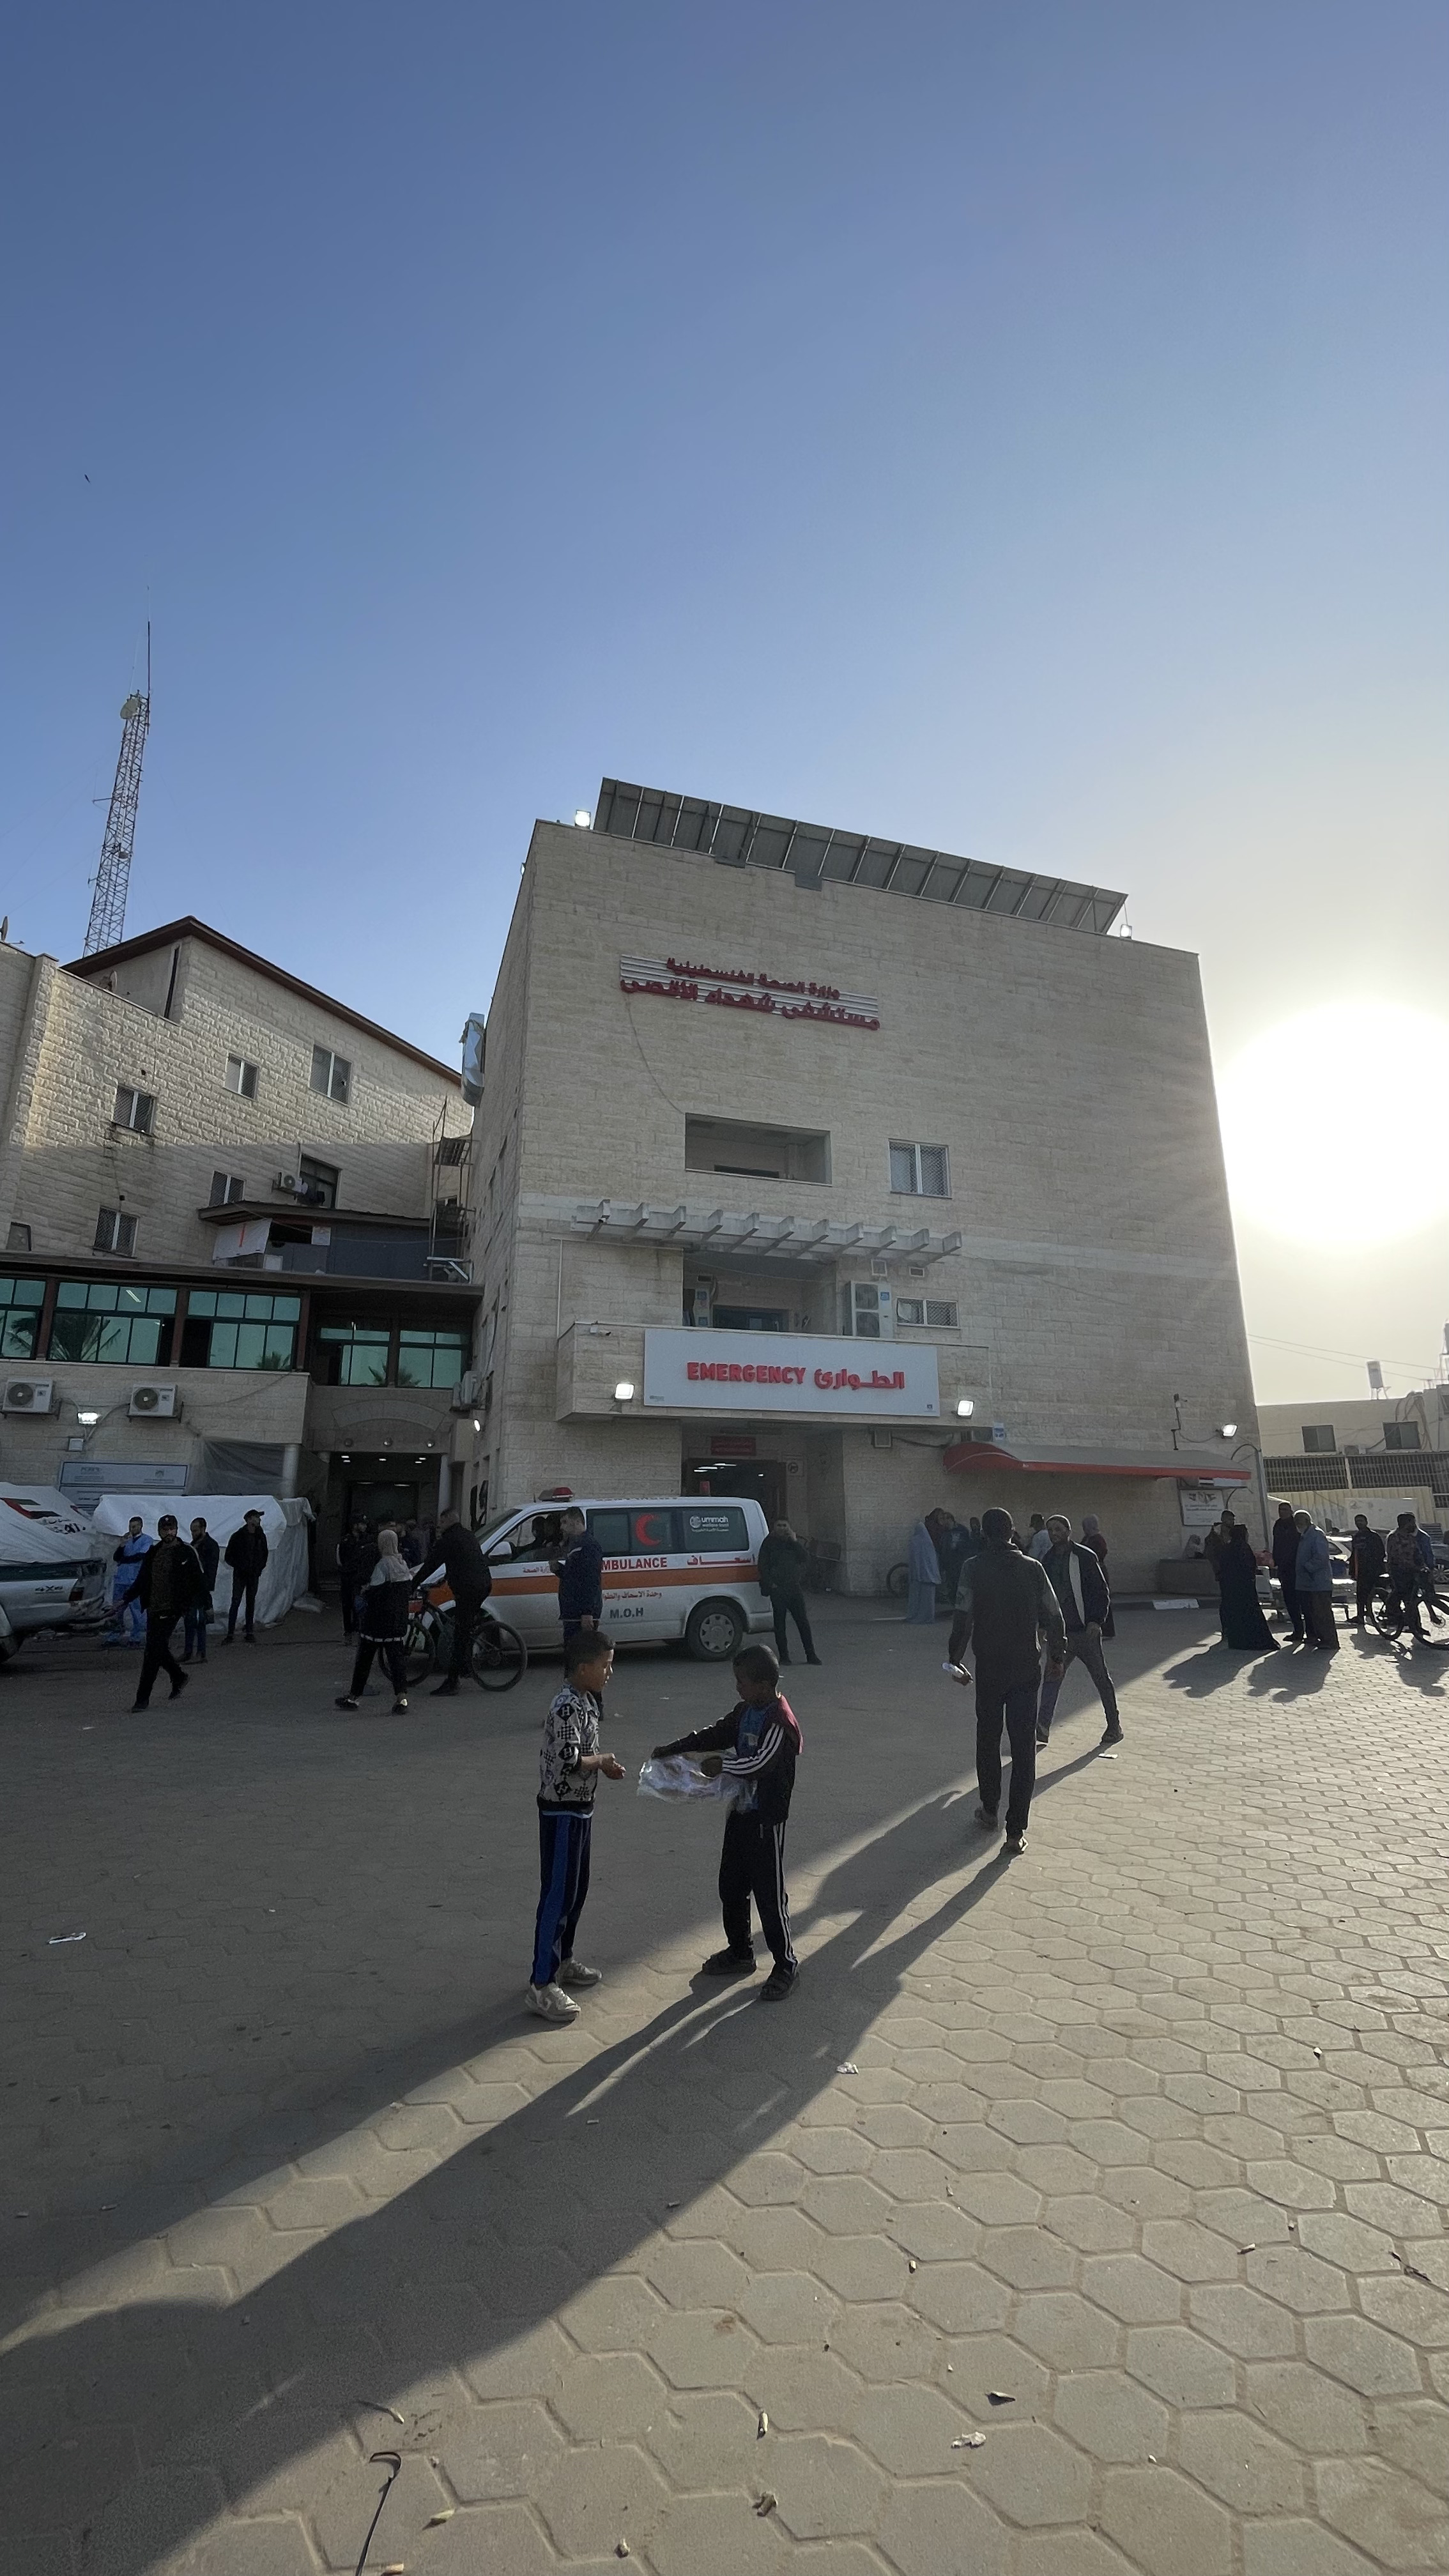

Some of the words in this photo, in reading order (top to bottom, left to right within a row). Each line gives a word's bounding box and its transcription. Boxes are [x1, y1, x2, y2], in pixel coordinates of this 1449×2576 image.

[666, 957, 755, 984] الفلسطينية
[758, 973, 805, 993] الصحة
[808, 982, 840, 1000] وزارة
[705, 987, 776, 1013] شهداء
[781, 1001, 880, 1031] مستشفى
[687, 1361, 807, 1384] EMERGENCY
[813, 1368, 905, 1390] الطوارئ
[601, 1557, 668, 1571] MBULANCE
[646, 1590, 663, 1598] وحدة
